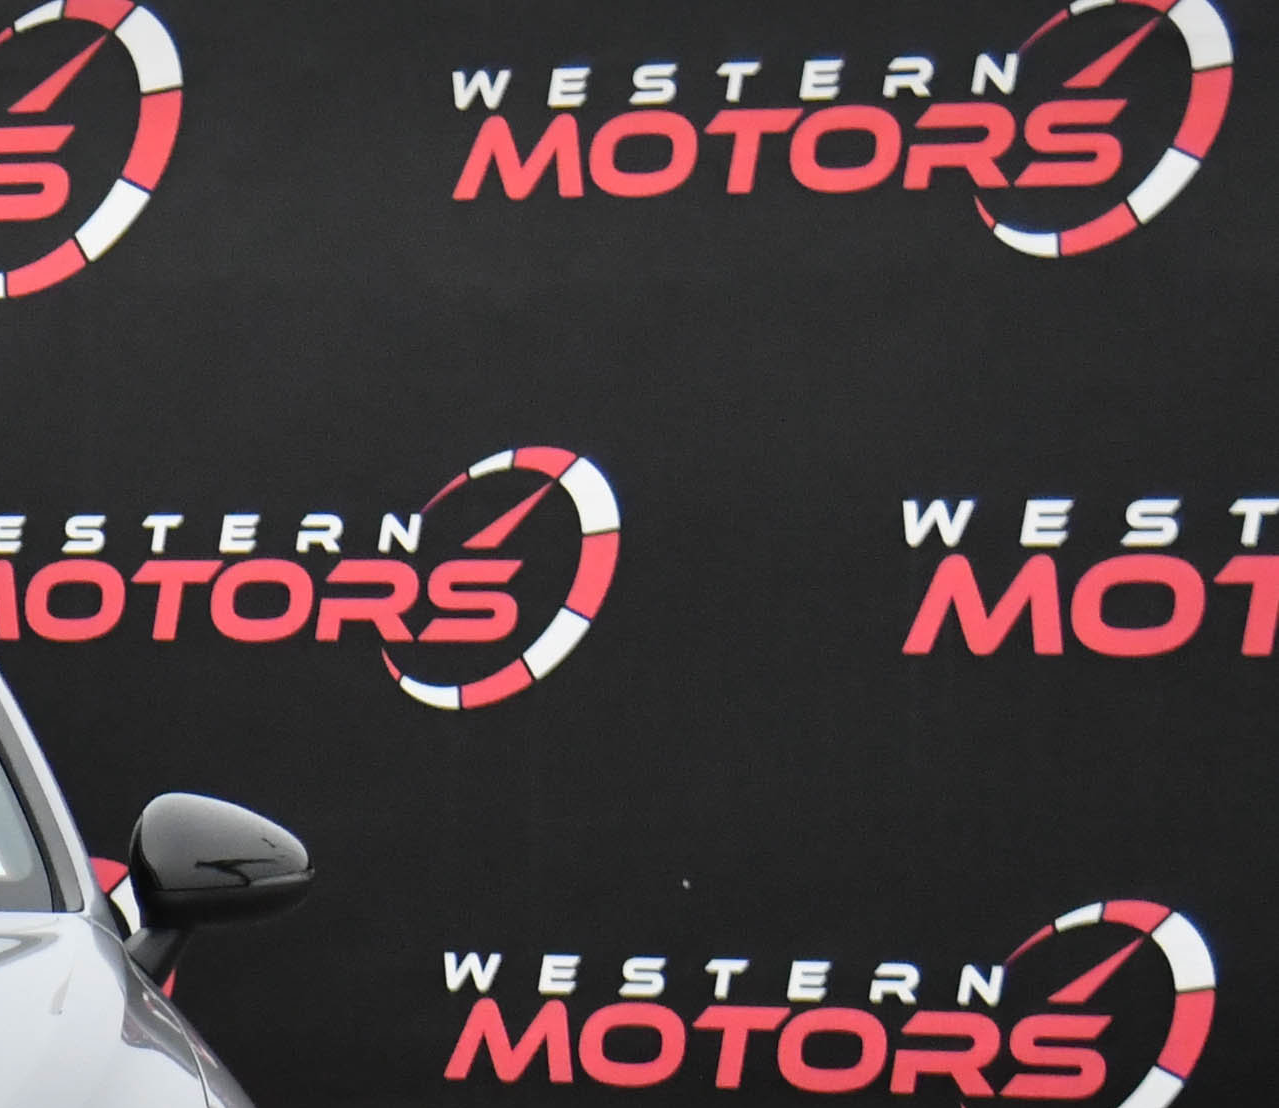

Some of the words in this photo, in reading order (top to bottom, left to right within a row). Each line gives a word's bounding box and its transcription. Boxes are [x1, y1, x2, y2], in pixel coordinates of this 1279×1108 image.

[451, 51, 1021, 111] WESTERN
[451, 98, 1129, 202] MOTORS
[442, 949, 1007, 1008] WESTERN
[442, 995, 1113, 1101] MOTORS
